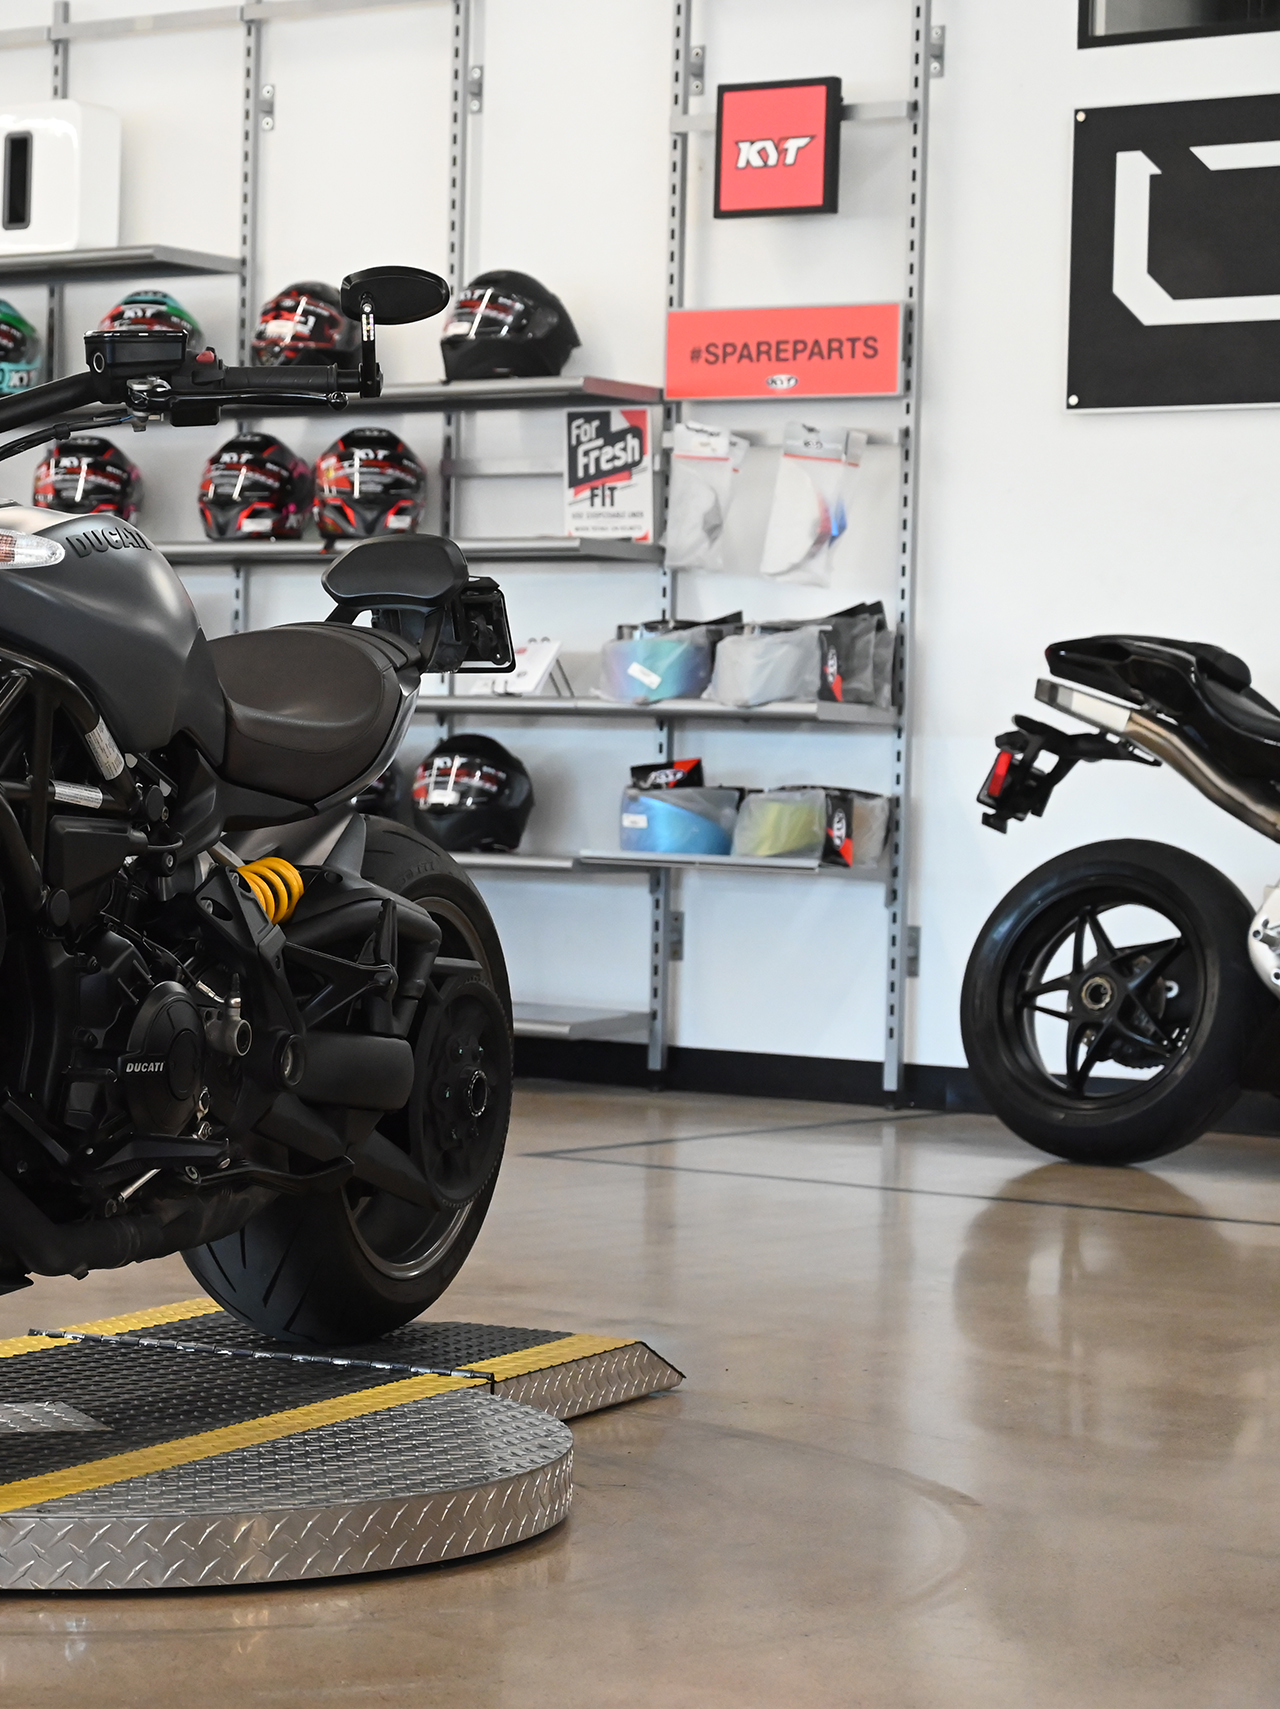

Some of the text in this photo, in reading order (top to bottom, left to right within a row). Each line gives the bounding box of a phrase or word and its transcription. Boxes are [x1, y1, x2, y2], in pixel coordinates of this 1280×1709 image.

[735, 135, 816, 169] KYT
[690, 336, 879, 365] #SPAREPARTS
[571, 418, 600, 446] For
[577, 433, 641, 478] Fresh
[590, 484, 618, 507] FIT
[66, 527, 152, 558] DUCATI
[126, 1062, 164, 1073] DUCATI
